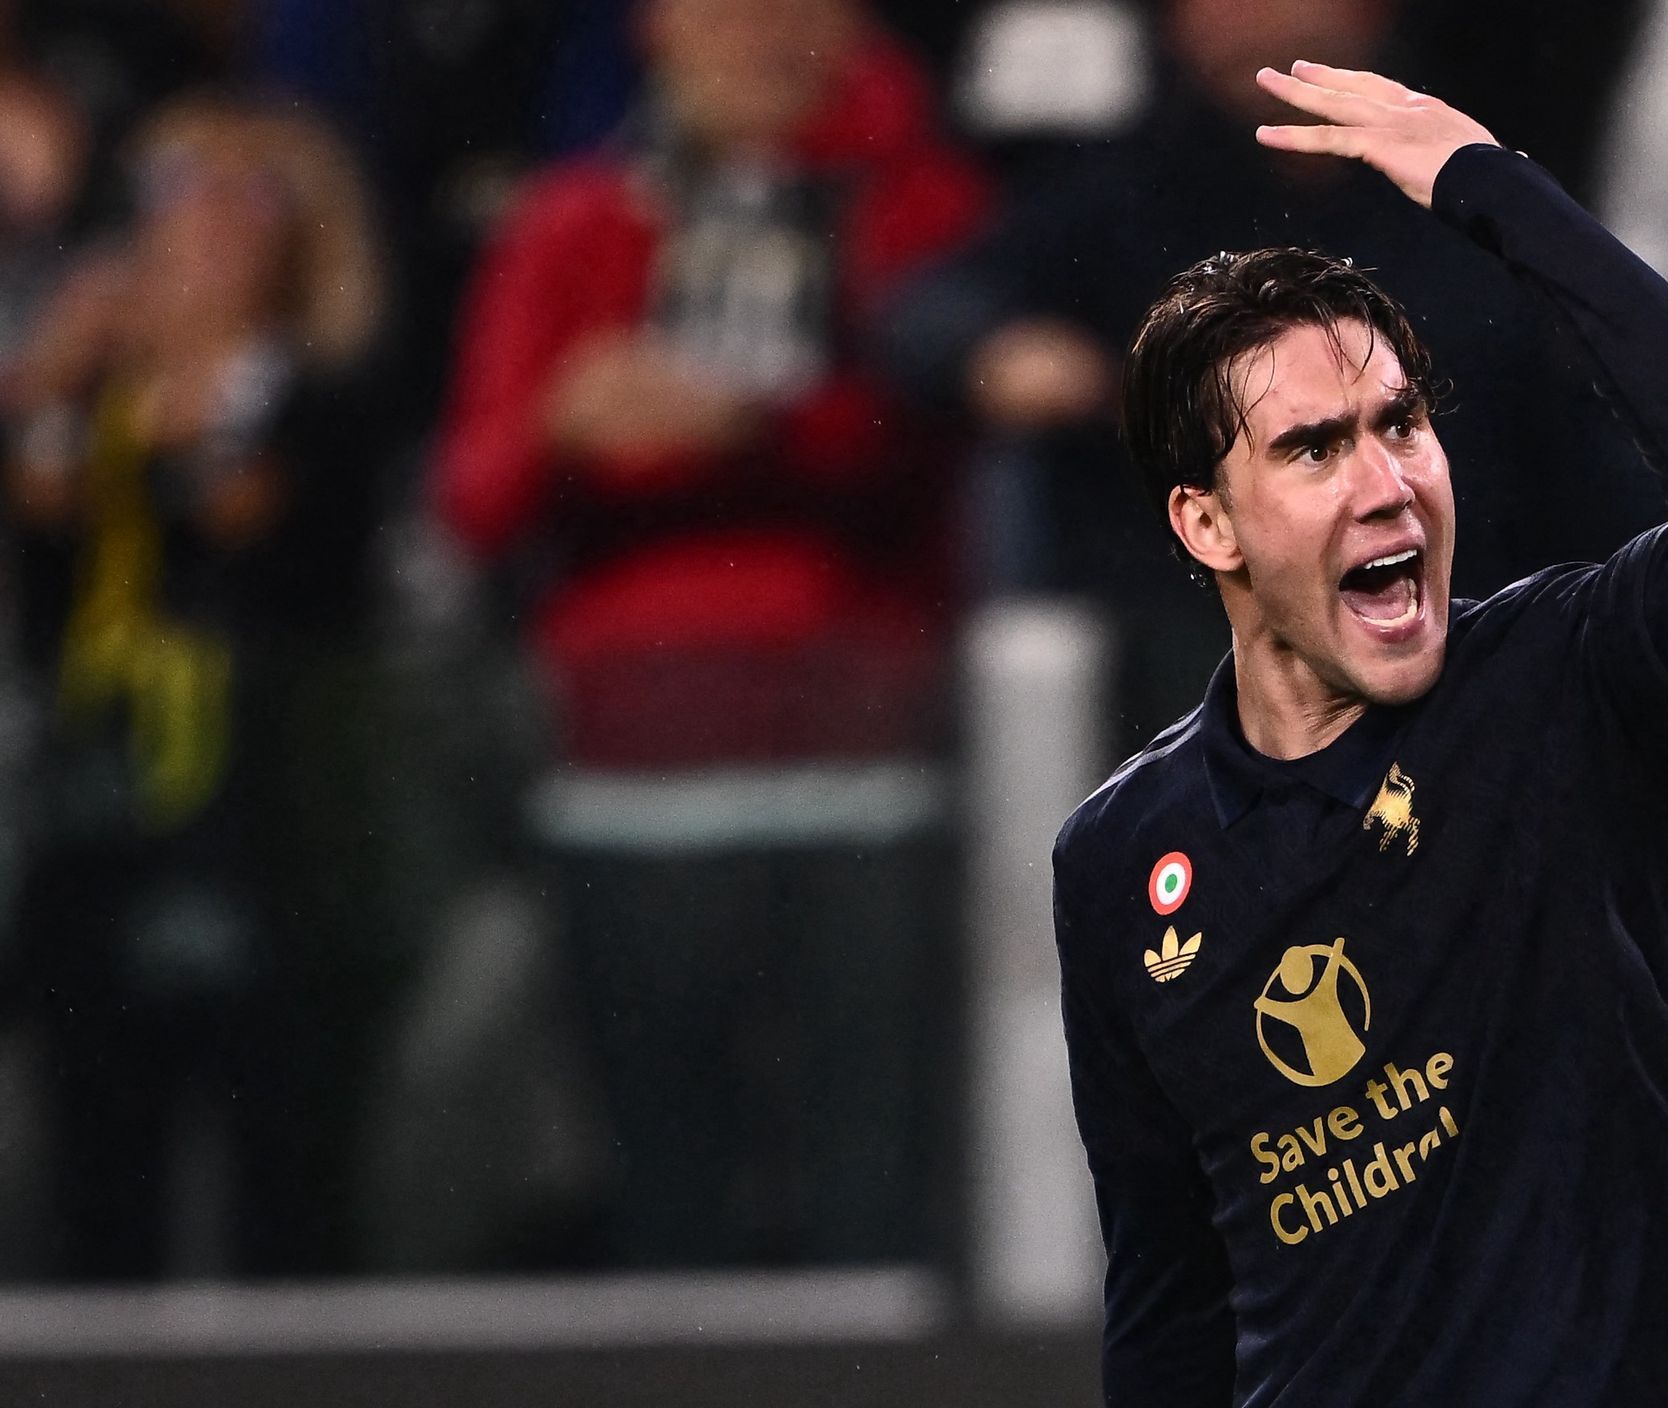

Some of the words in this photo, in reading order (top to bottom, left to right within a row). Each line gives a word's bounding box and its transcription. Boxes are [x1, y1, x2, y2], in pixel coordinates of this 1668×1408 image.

[1250, 1106, 1365, 1184] Save
[1365, 1052, 1454, 1120] the
[1270, 1106, 1459, 1245] Childr
